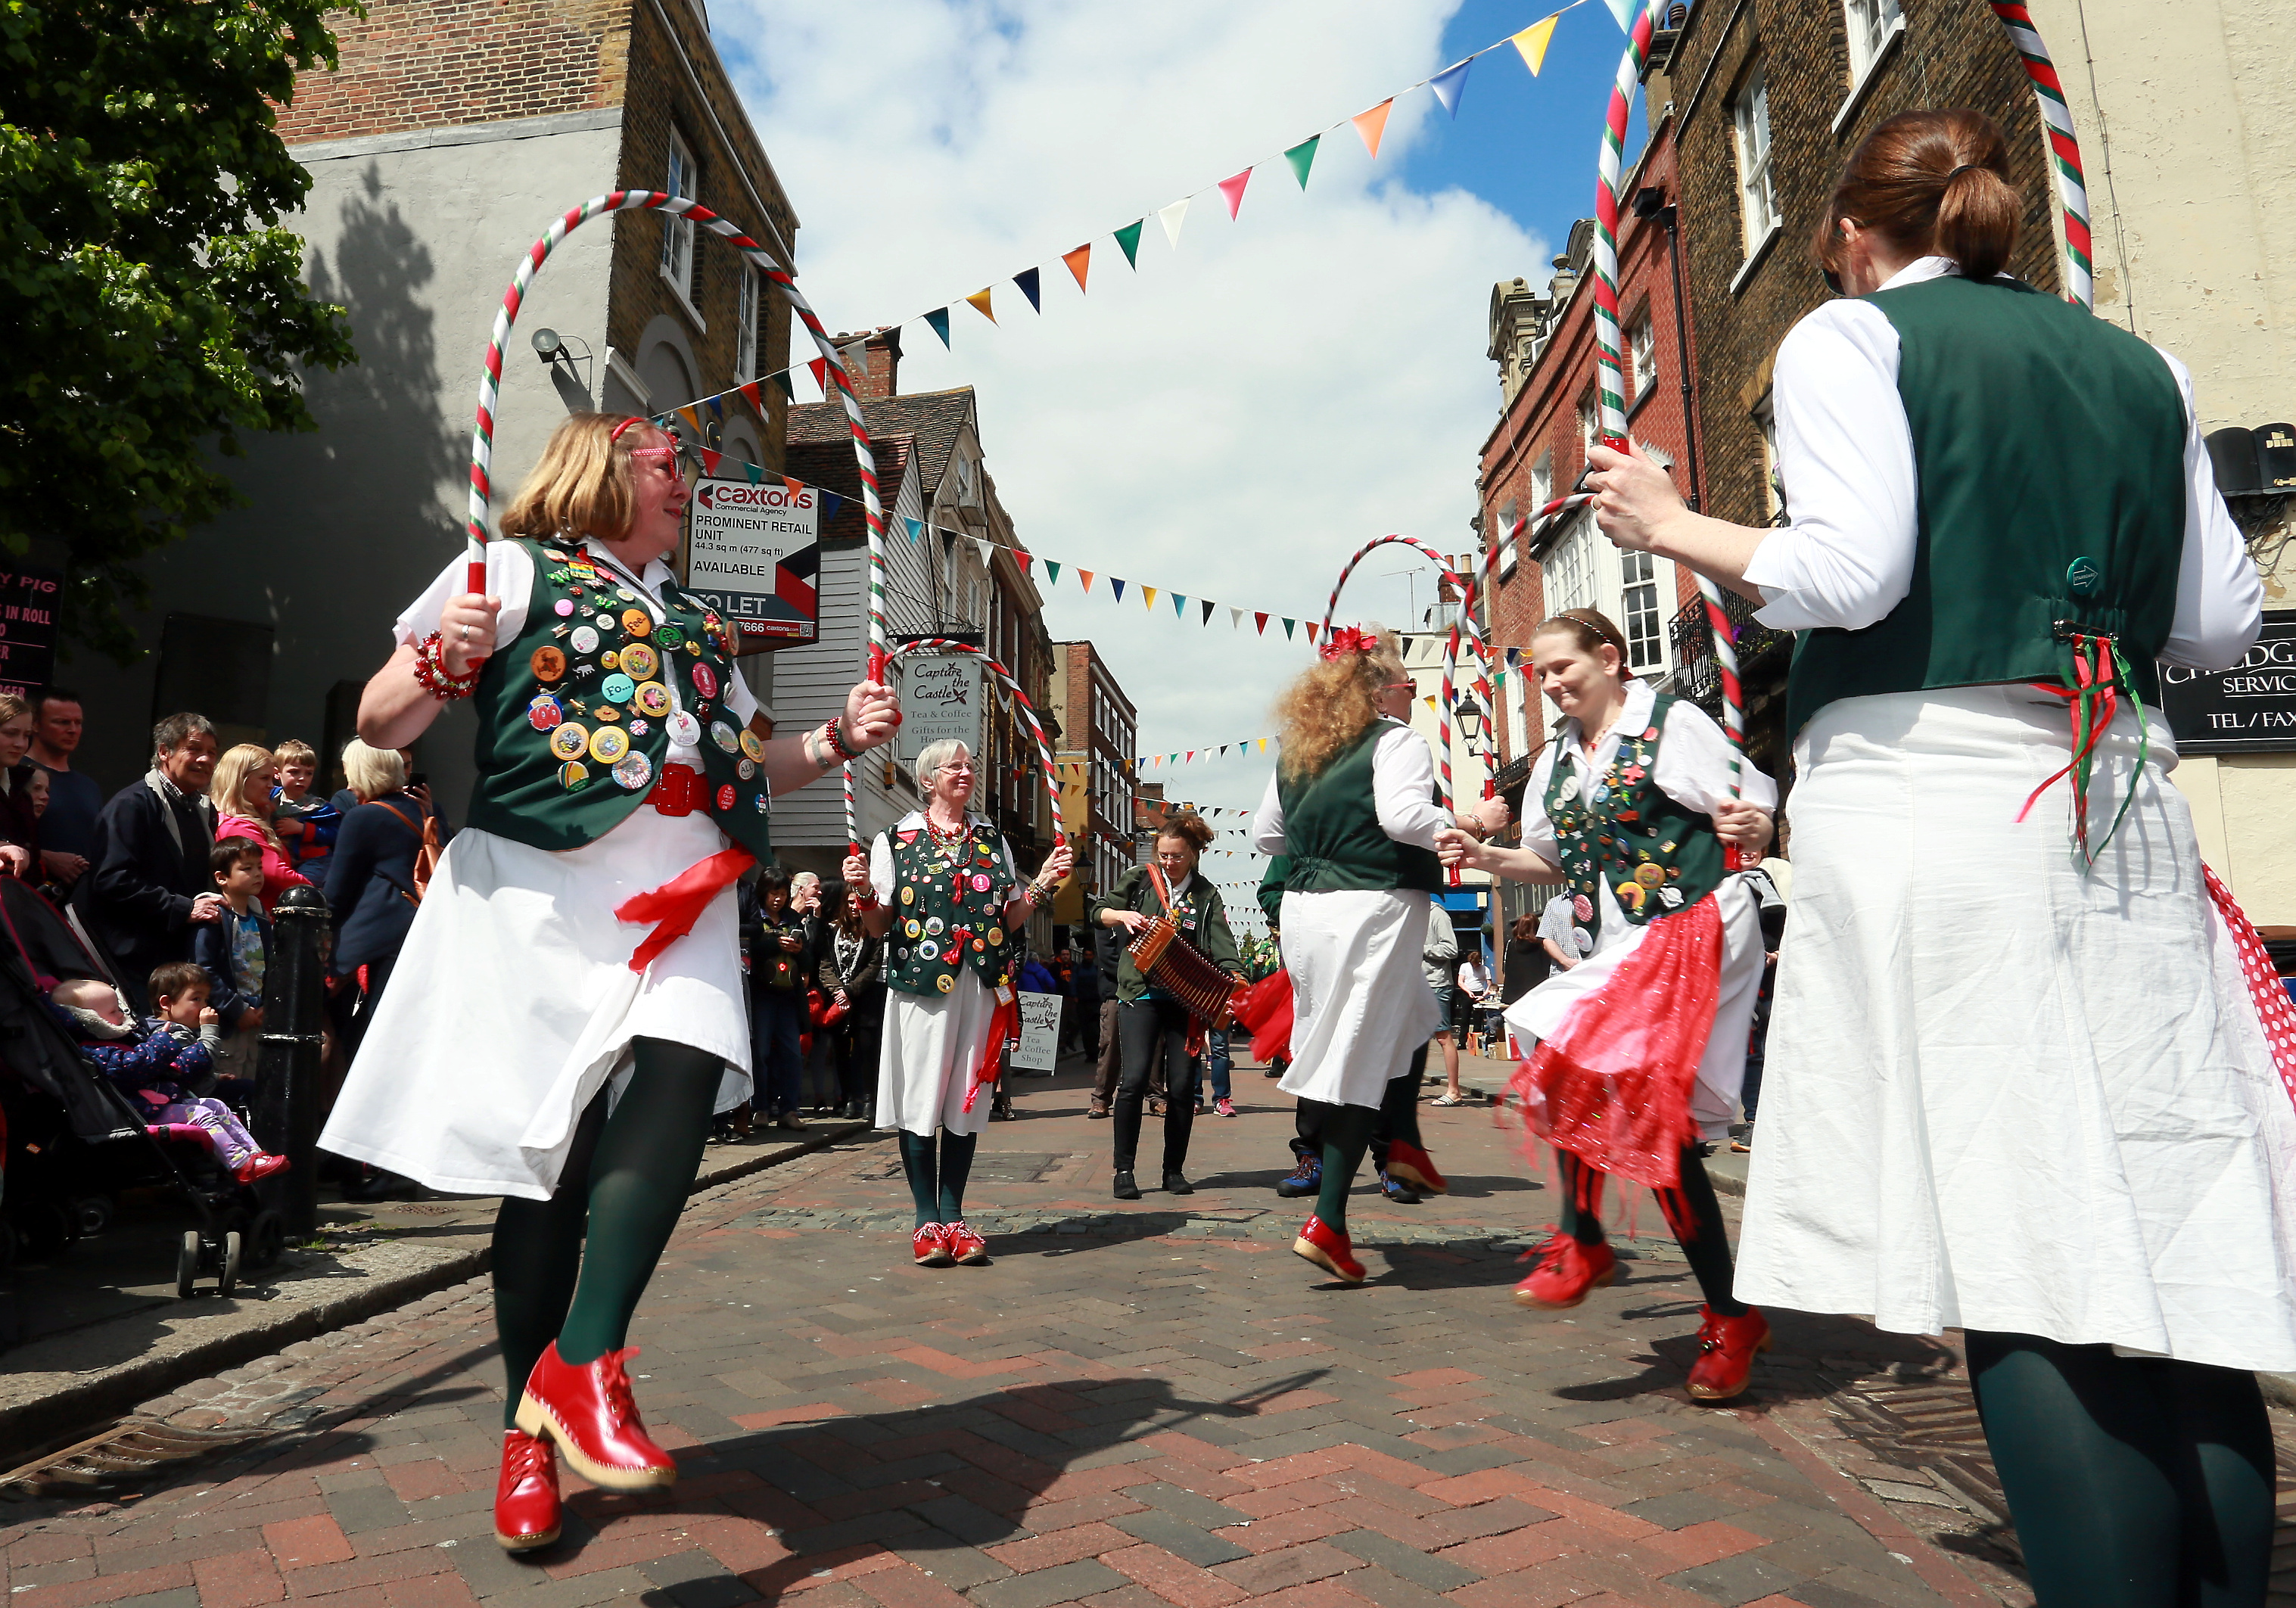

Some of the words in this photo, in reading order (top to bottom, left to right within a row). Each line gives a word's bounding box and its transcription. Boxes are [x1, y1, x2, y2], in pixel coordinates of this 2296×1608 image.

[715, 486, 813, 509] caxtons
[714, 503, 758, 512] Commercial
[760, 507, 787, 516] Agency
[695, 515, 768, 531] PROMINENT
[771, 521, 813, 535] RETAIL
[695, 528, 724, 541] UNIT
[695, 541, 714, 551] 44.3
[716, 544, 726, 552] sq
[740, 544, 759, 554] (477
[761, 548, 772, 557] sq
[774, 547, 784, 557] ft)
[693, 560, 765, 577] AVAILABLE
[19, 576, 58, 593] PIG
[726, 595, 767, 614] LET
[5, 605, 19, 620] IN
[22, 607, 51, 625] ROLL
[914, 662, 963, 680] Capture
[952, 674, 970, 687] the
[913, 685, 952, 698] Castle
[930, 710, 938, 718] &
[941, 709, 972, 718] Coffee
[2207, 713, 2245, 729] TEL
[912, 726, 935, 734] Gifts
[937, 726, 951, 734] for
[954, 725, 969, 733] the
[741, 764, 753, 773] ALL
[1019, 995, 1053, 1009] Capture
[1044, 1007, 1058, 1018] the
[1026, 1036, 1041, 1044] Tea
[1025, 1045, 1051, 1054] Coffee
[1021, 1054, 1043, 1065] Shop
